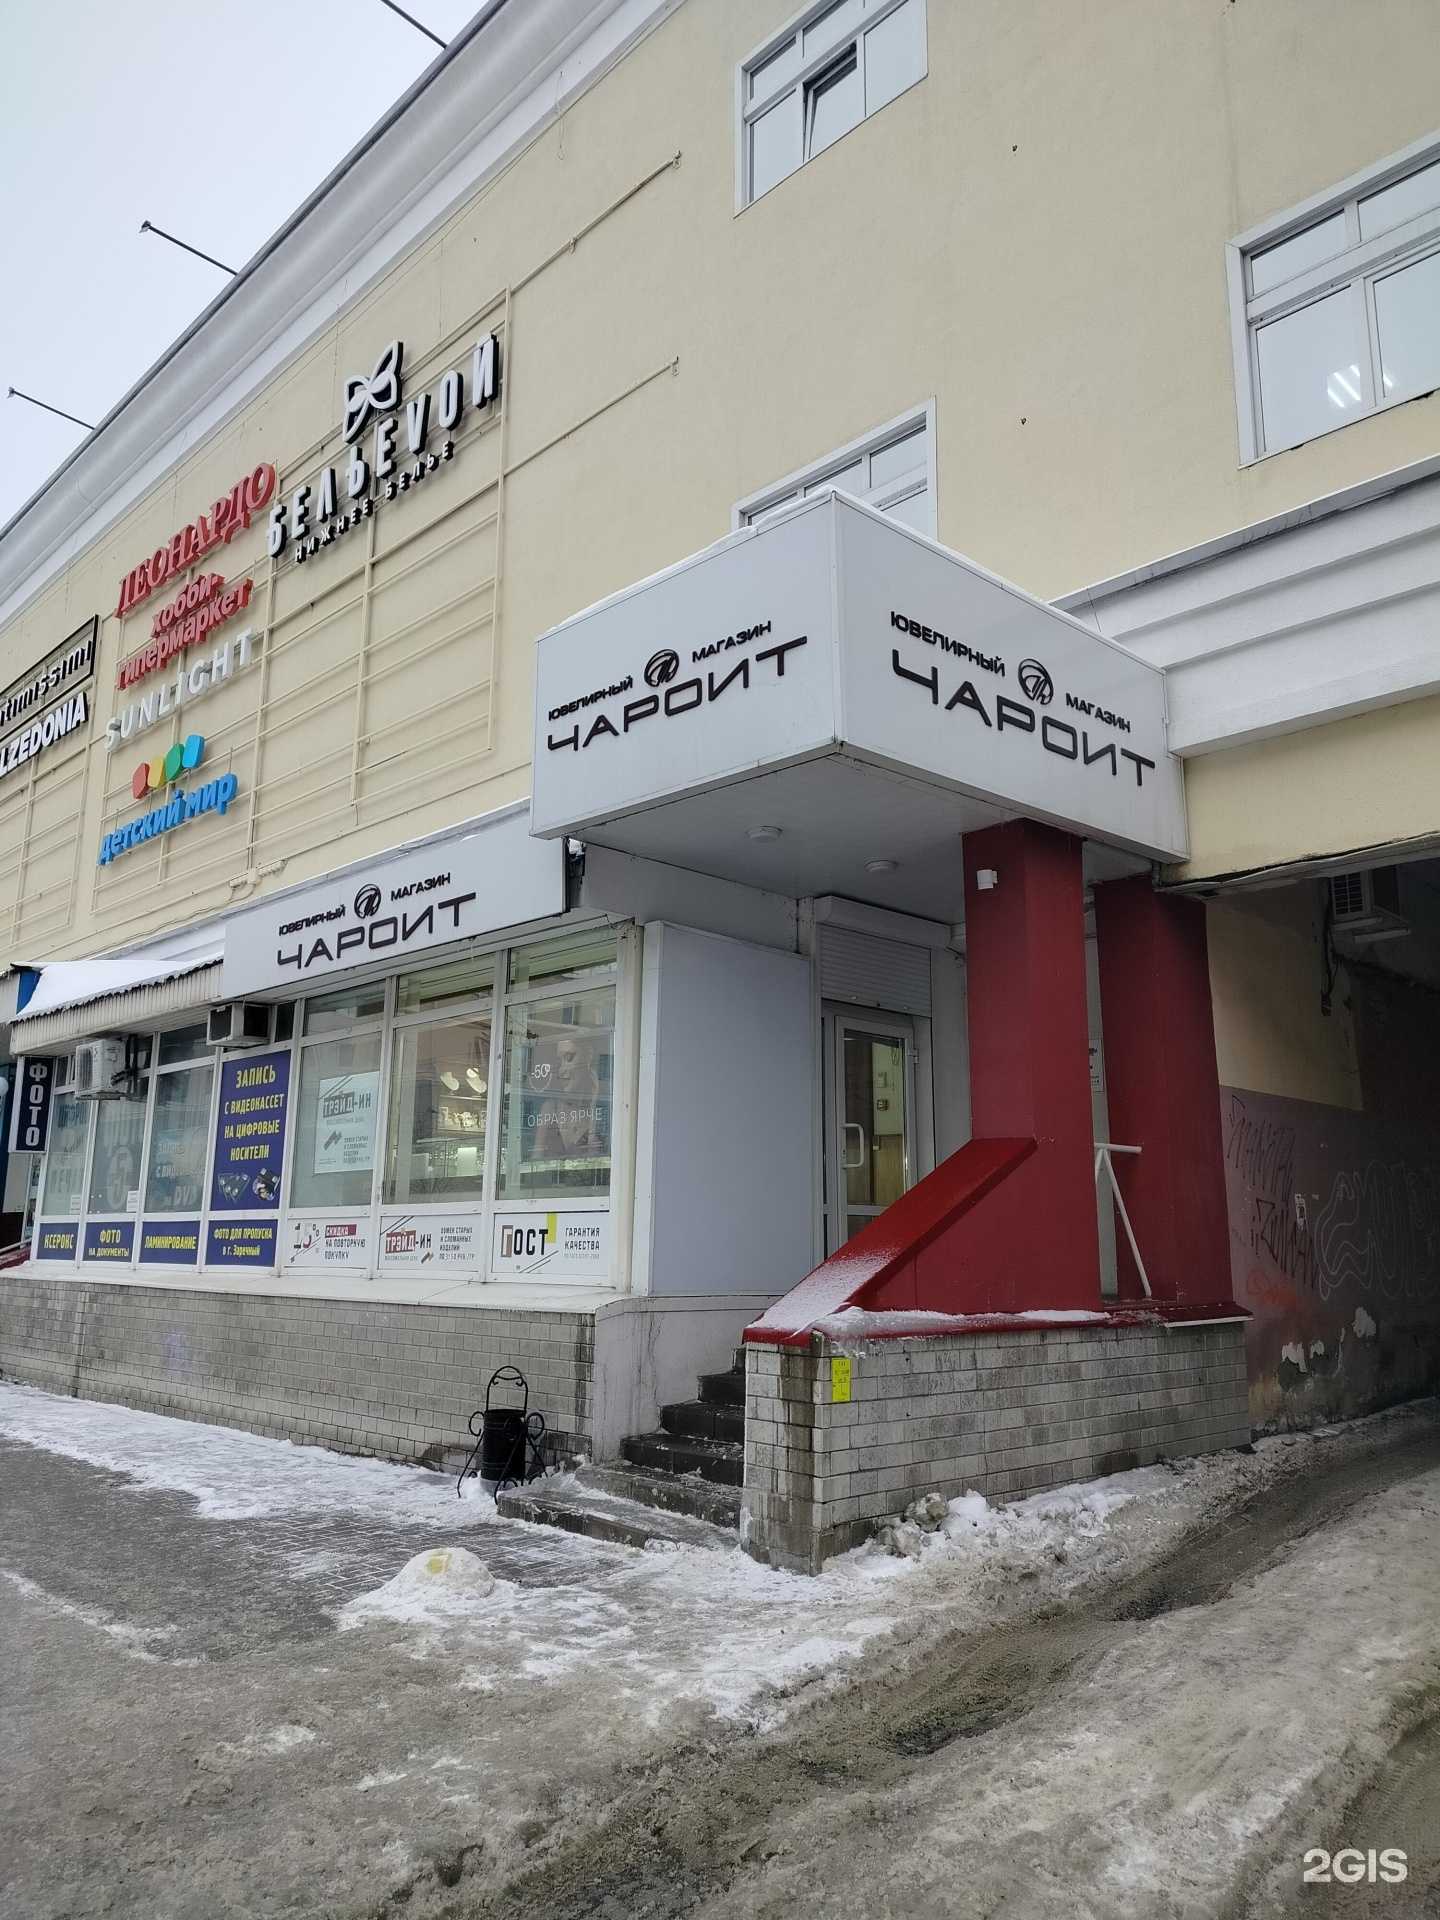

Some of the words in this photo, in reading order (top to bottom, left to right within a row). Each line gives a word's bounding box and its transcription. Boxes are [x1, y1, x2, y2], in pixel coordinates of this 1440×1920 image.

[294, 498, 373, 563] НИЖНЕЕ
[384, 441, 454, 500] БЕЛЬЕ
[114, 462, 276, 618] ЛЕОНАРДО
[117, 577, 254, 690] гипермаркет
[548, 675, 633, 721] ЮВЕЛИРНЫЙ
[692, 620, 771, 663] МАГАЗИН
[890, 610, 1006, 678] ЮВЕЛИРНЫЙ
[1065, 692, 1131, 733] МАГАЗИН
[105, 629, 254, 752] SUNLIGHT
[547, 635, 808, 752] ЧАРОИТ
[892, 649, 1156, 787] ЧАРОИТ
[98, 787, 186, 865] детский
[185, 772, 239, 817] мир
[278, 903, 346, 936] ЮВЕЛИРНЫЙ
[390, 872, 451, 901] МАГАЗИН
[277, 892, 477, 970] ЧАРОИТ
[235, 1065, 276, 1089] ЗАПИСЬ
[25, 1063, 48, 1147] ФОТО
[224, 1101, 230, 1115] С
[230, 1093, 285, 1115] ВИДЕОКАССЕТ
[224, 1124, 235, 1139] НА
[235, 1119, 281, 1140] ЦИФРОВЫЕ
[230, 1144, 270, 1161] НОСИТЕЛИ
[44, 1233, 74, 1249] КСЕРОКС
[99, 1229, 121, 1244] ФОТО
[144, 1235, 197, 1249] ЛАМИНИРОВАНИЕ
[213, 1228, 230, 1240] ФОТО
[230, 1228, 242, 1240] ДЛЯ
[243, 1228, 272, 1239] ПРОПУСКА
[385, 1231, 432, 1253] ТРЭЙД-ИН
[501, 1225, 548, 1257] ГОСТ
[565, 1227, 600, 1237] ГАРАНТИЯ
[565, 1240, 600, 1250] КАЧЕСТВА
[88, 1247, 95, 1256] НА
[96, 1246, 129, 1258] ДОКУМЕНТЫ
